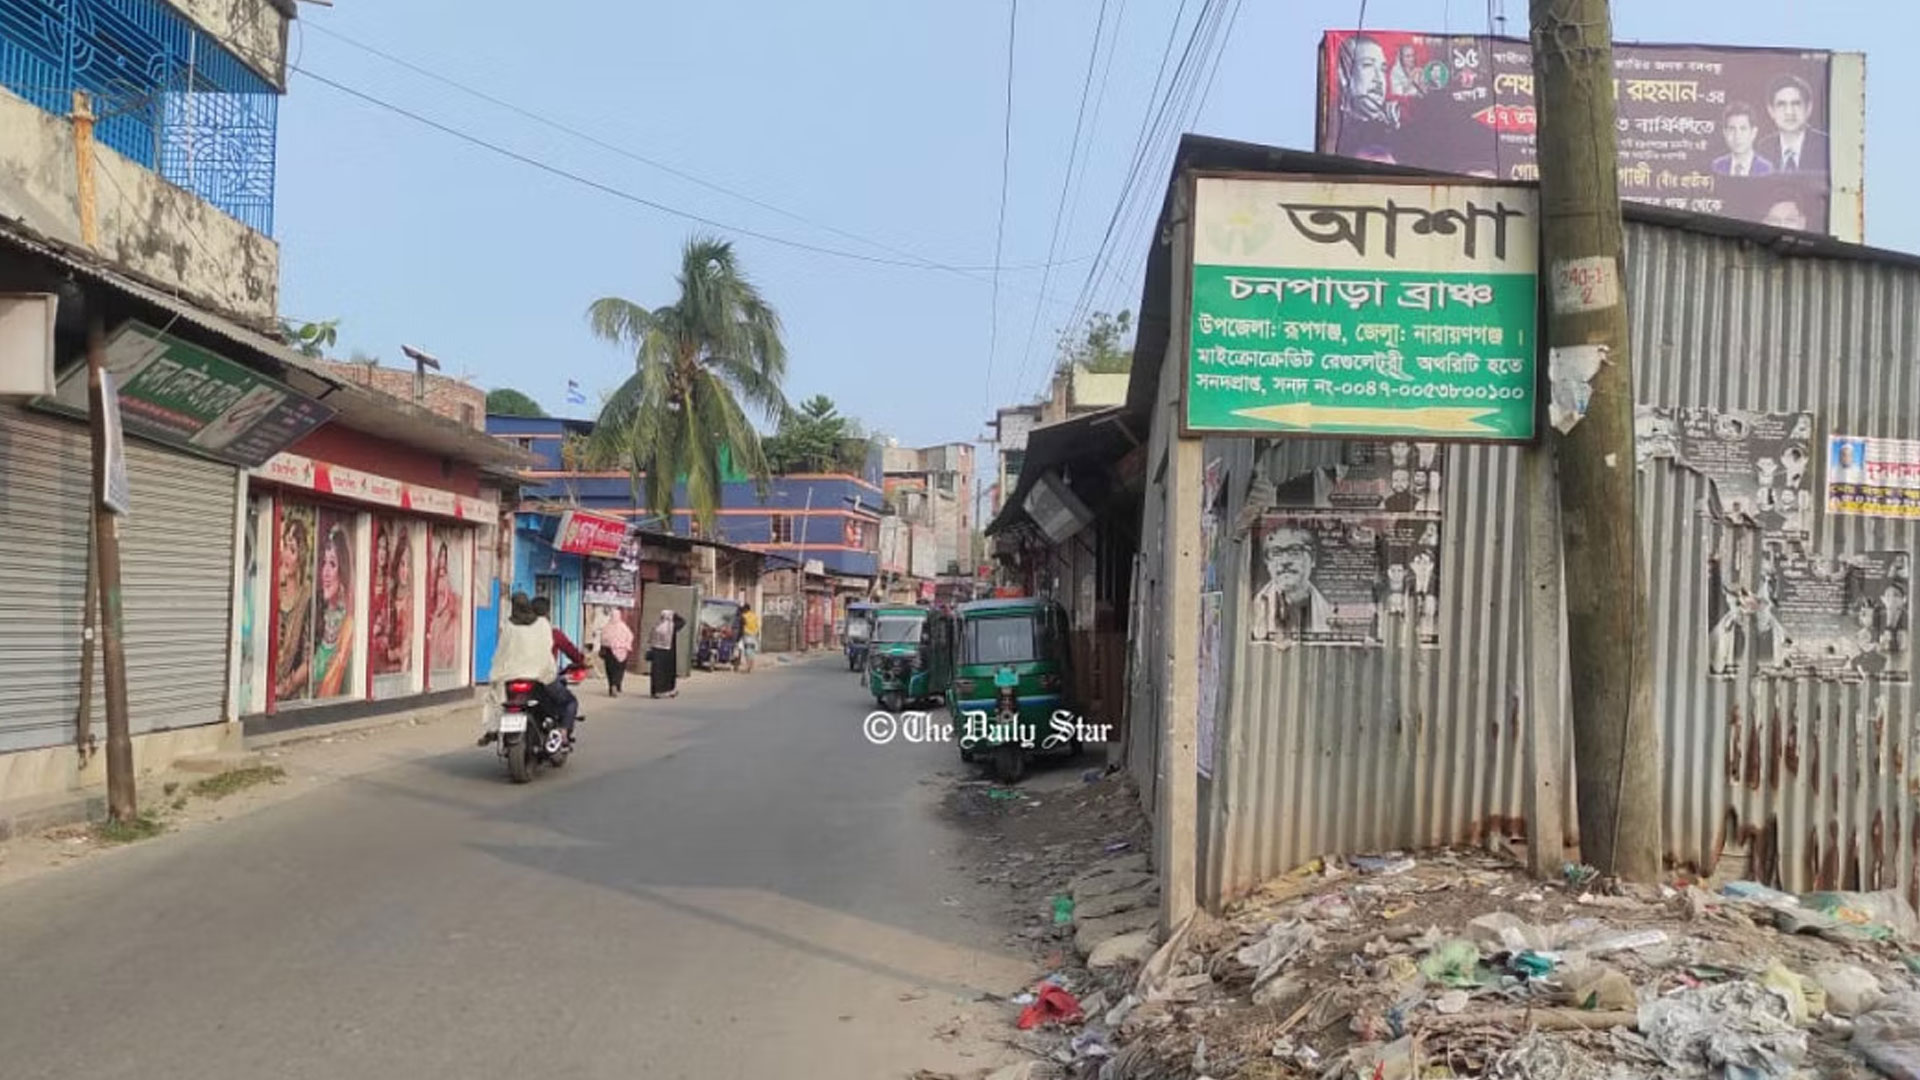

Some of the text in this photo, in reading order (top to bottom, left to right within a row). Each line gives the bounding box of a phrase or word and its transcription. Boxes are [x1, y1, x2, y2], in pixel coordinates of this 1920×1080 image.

[1278, 199, 1526, 260] আশা
[1224, 276, 1493, 312] চনপাড়া ব্রাঞ্চ
[1413, 324, 1504, 346] নারায়ণগঞ্জ
[1486, 357, 1524, 376] হতে
[1272, 376, 1310, 394] সনদ
